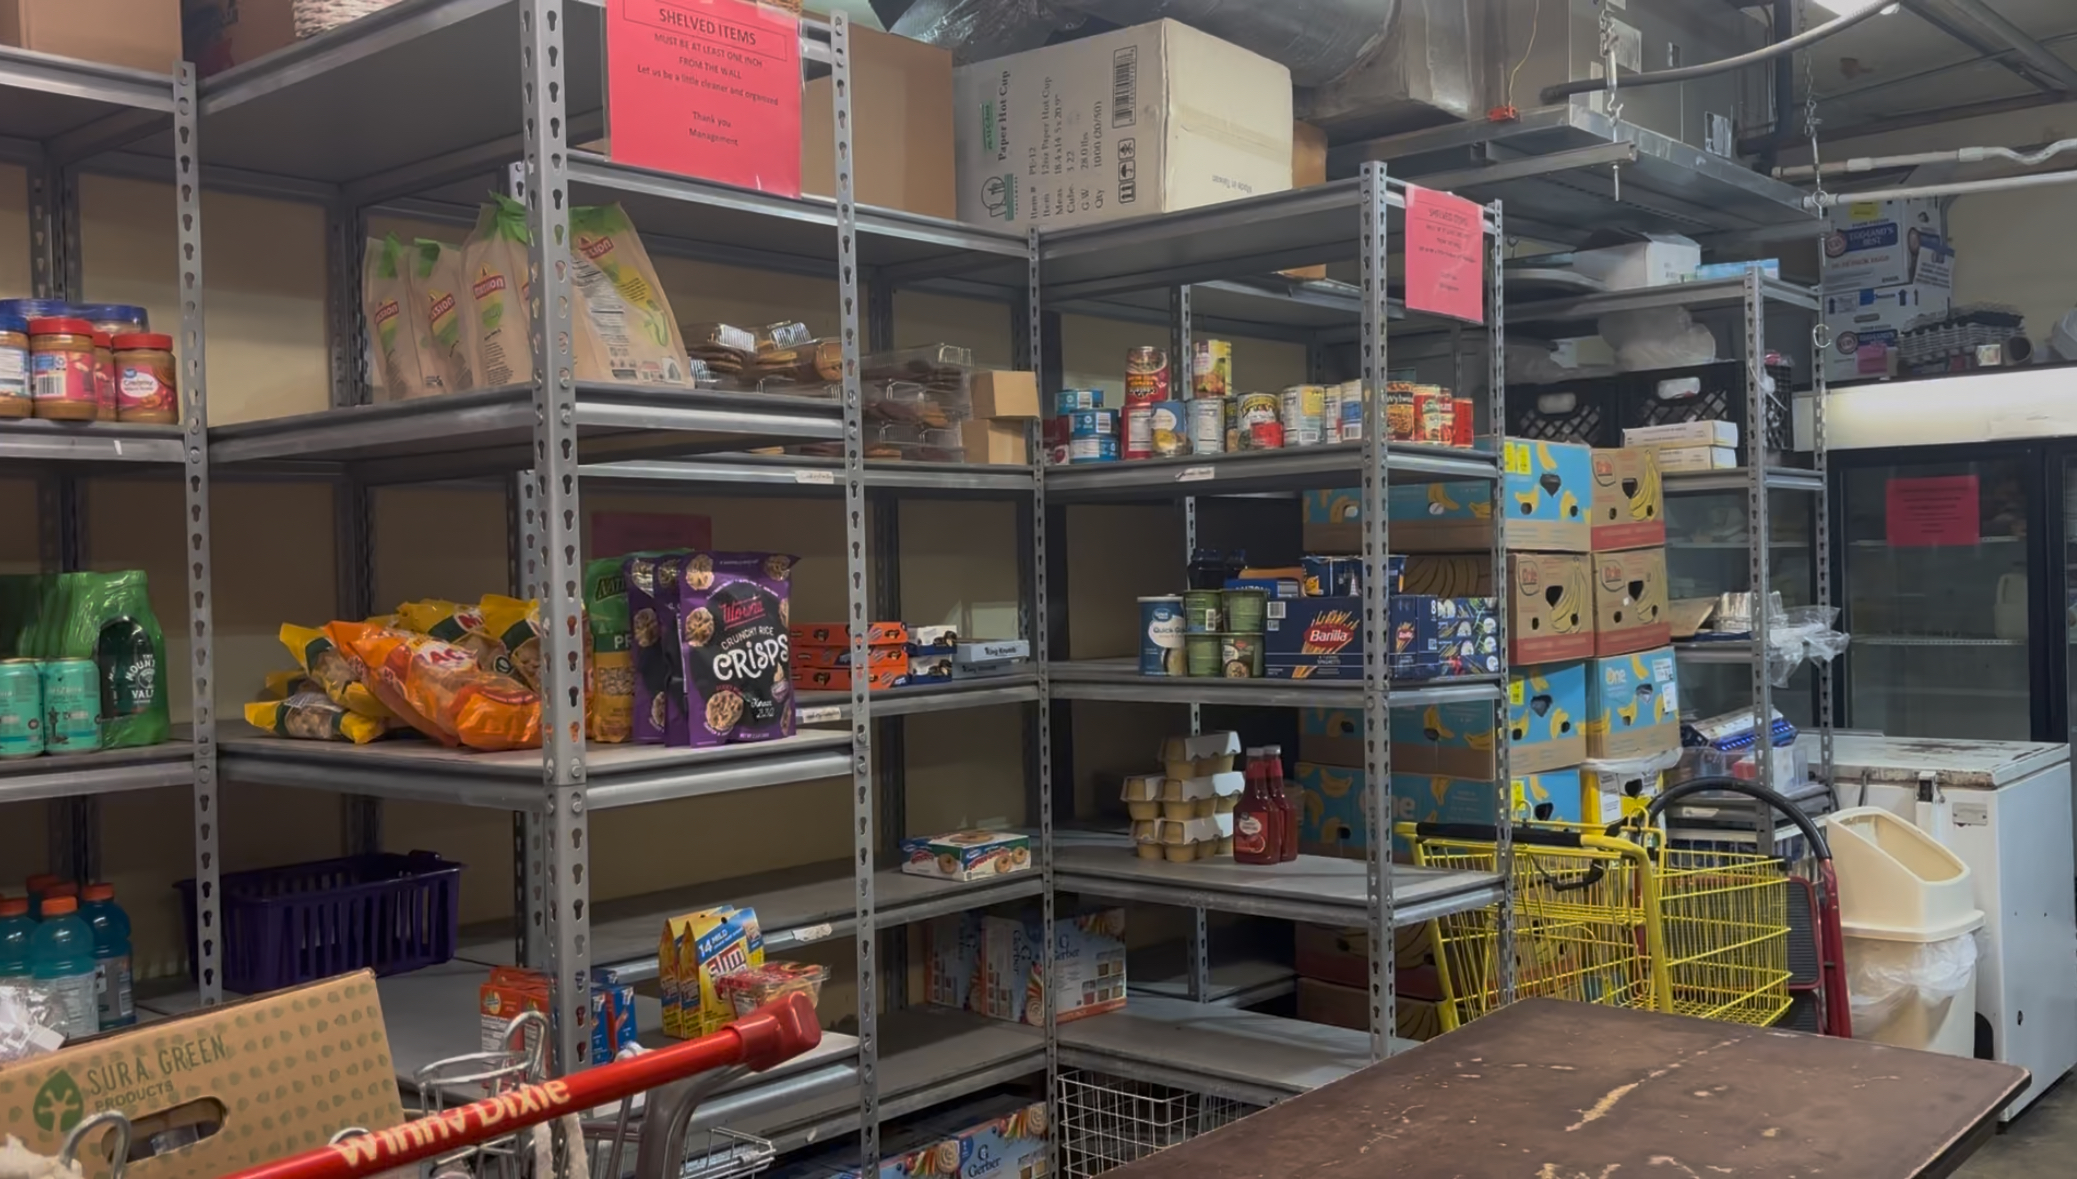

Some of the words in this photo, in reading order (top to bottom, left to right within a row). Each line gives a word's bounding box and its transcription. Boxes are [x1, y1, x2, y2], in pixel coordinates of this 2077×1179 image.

[659, 8, 715, 34] SHELVED
[718, 26, 756, 46] ITEMS
[654, 33, 678, 47] MUST
[679, 40, 690, 49] BE
[691, 42, 701, 51] AT
[703, 45, 725, 59] LEAST
[727, 51, 743, 63] ONE
[637, 64, 650, 75] Let
[652, 69, 661, 78] us
[663, 70, 673, 80] be
[682, 74, 699, 86] little
[701, 79, 728, 93] cleaner
[730, 85, 744, 97] and
[679, 56, 703, 70] FROM
[704, 62, 719, 74] THE
[720, 66, 742, 80] WALL
[998, 71, 1010, 96] Cup
[1041, 76, 1052, 98] Cup
[692, 111, 715, 123] Thank
[717, 119, 731, 128] you
[998, 99, 1007, 123] Hot
[1041, 102, 1050, 120] Hot
[689, 128, 739, 146] Management
[998, 126, 1010, 161] Paper
[1041, 122, 1051, 150] Paper
[1029, 146, 1037, 175] PE-12
[1094, 145, 1102, 167] 1000
[1030, 195, 1038, 219] Item
[1042, 192, 1050, 217] Item
[721, 627, 757, 649] CRUNCHY
[759, 626, 774, 636] RICE
[1309, 629, 1349, 642] Barilla
[699, 938, 713, 958] 14
[712, 929, 728, 943] MILD
[87, 1056, 150, 1096] SURA
[158, 1035, 226, 1076] GREEN
[95, 1080, 175, 1113] PRODUCTS
[472, 1079, 571, 1127] Dixie
[968, 1157, 1002, 1178] Gerber
